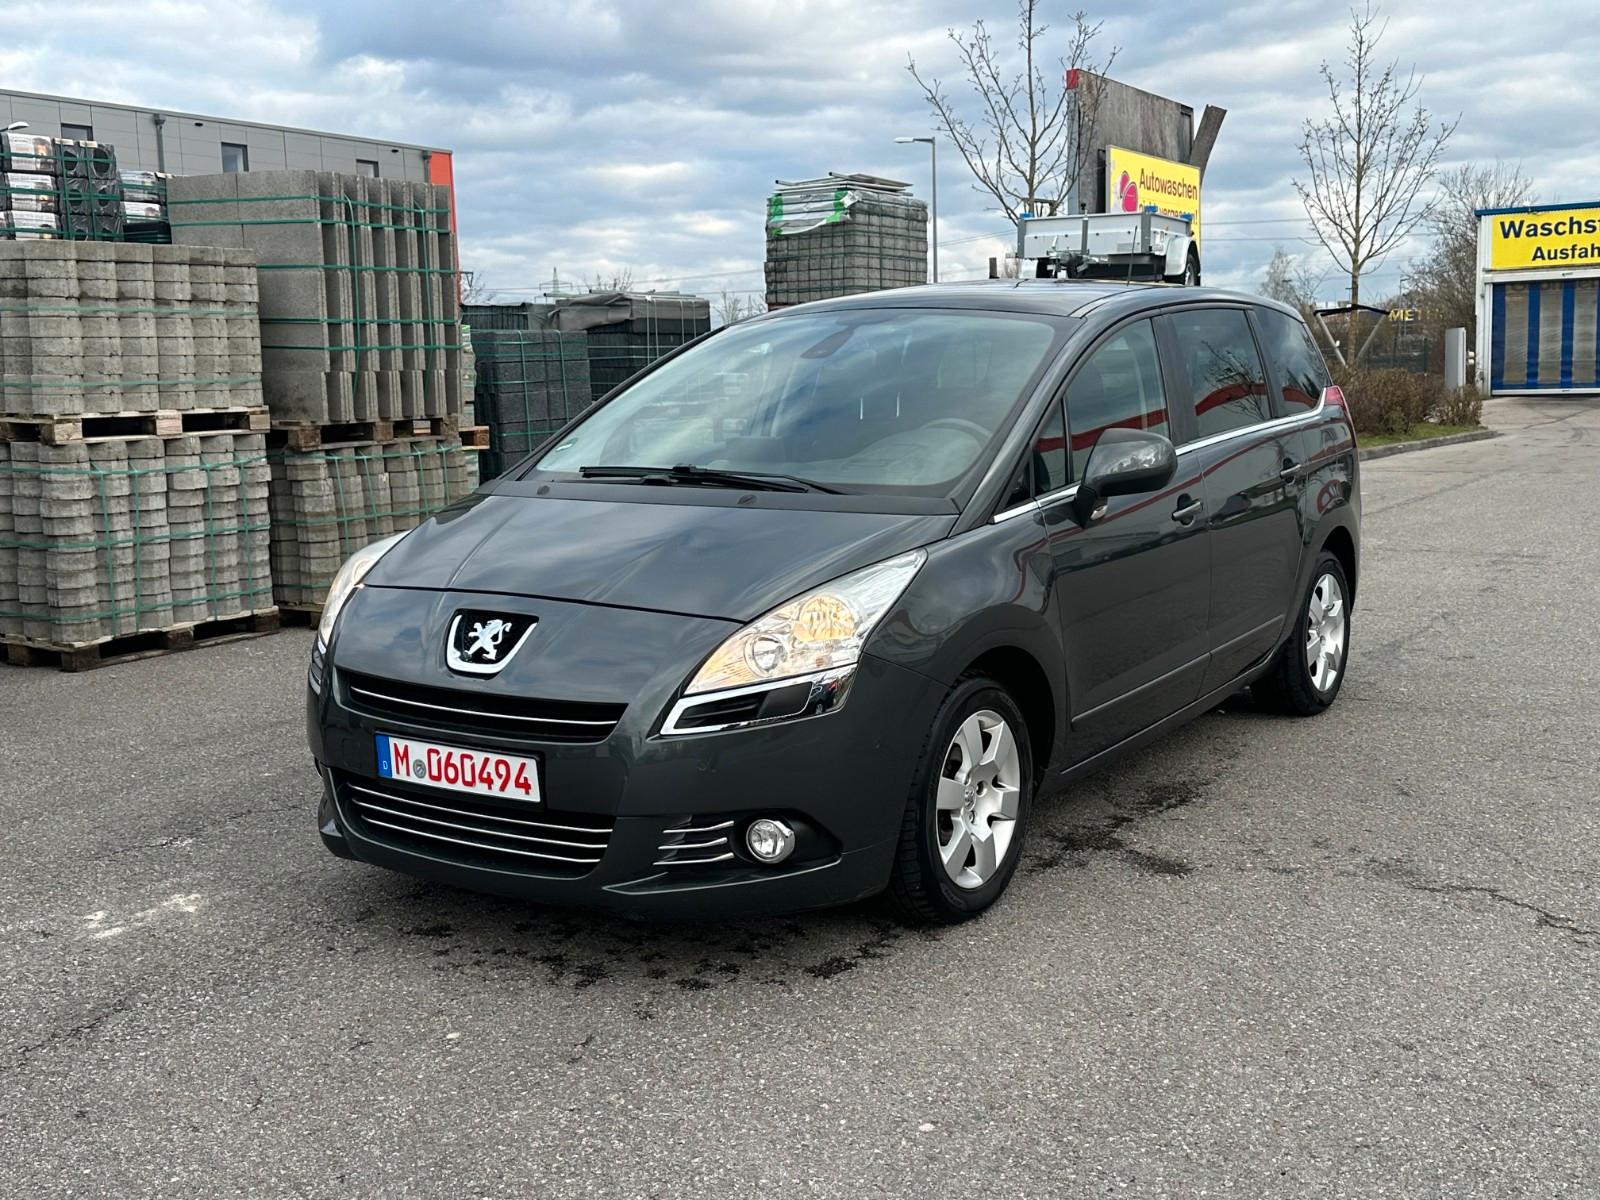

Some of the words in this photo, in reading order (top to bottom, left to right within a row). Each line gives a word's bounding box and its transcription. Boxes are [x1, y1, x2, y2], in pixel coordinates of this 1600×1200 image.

[1139, 167, 1198, 201] Autowaschen
[1499, 215, 1600, 239] Waschs
[1531, 242, 1600, 262] Ausfah
[382, 760, 389, 770] D
[393, 742, 411, 777] M
[426, 748, 532, 796] 060494
